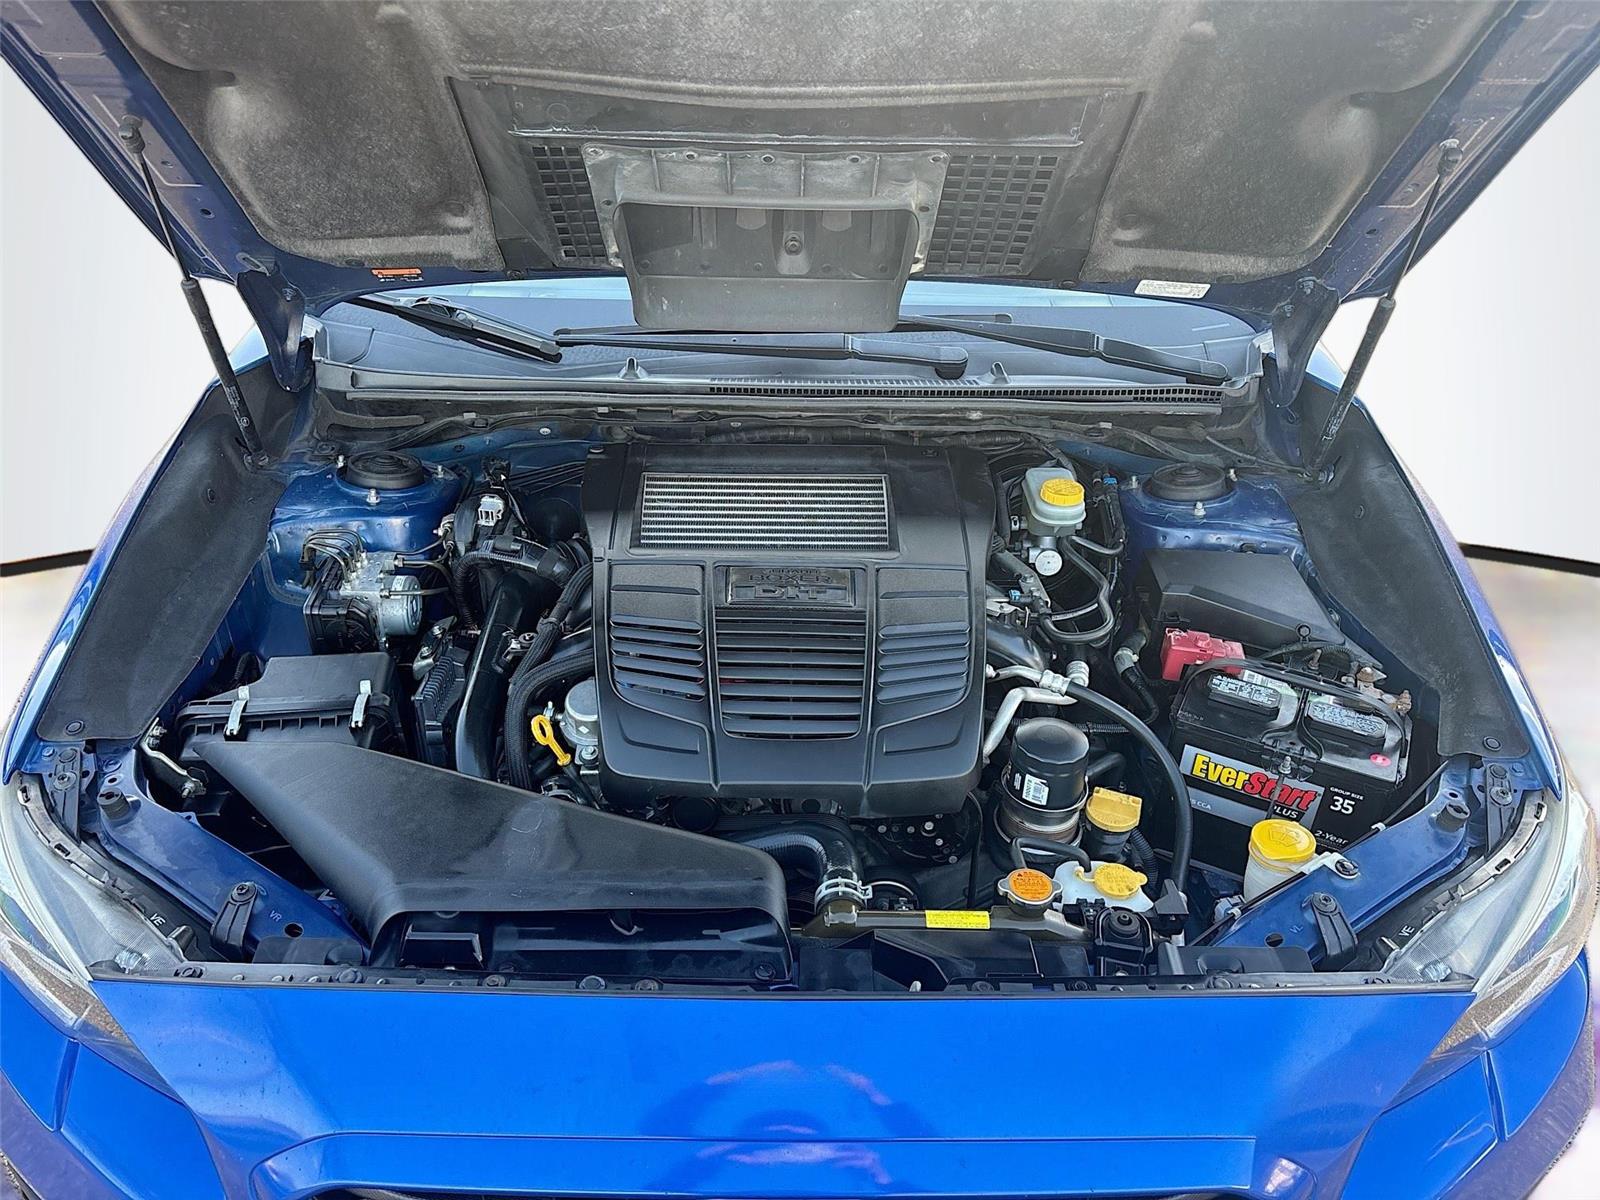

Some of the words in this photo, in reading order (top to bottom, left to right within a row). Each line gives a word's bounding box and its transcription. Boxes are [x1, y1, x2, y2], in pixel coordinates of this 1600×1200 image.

[1192, 753, 1318, 811] EverStart
[1330, 786, 1351, 796] GROUP
[1351, 793, 1364, 801] SIZE
[1330, 796, 1356, 815] 35
[1314, 829, 1349, 845] 2-Year
[149, 913, 166, 926] VE
[269, 910, 282, 922] VR
[1399, 925, 1415, 937] VE
